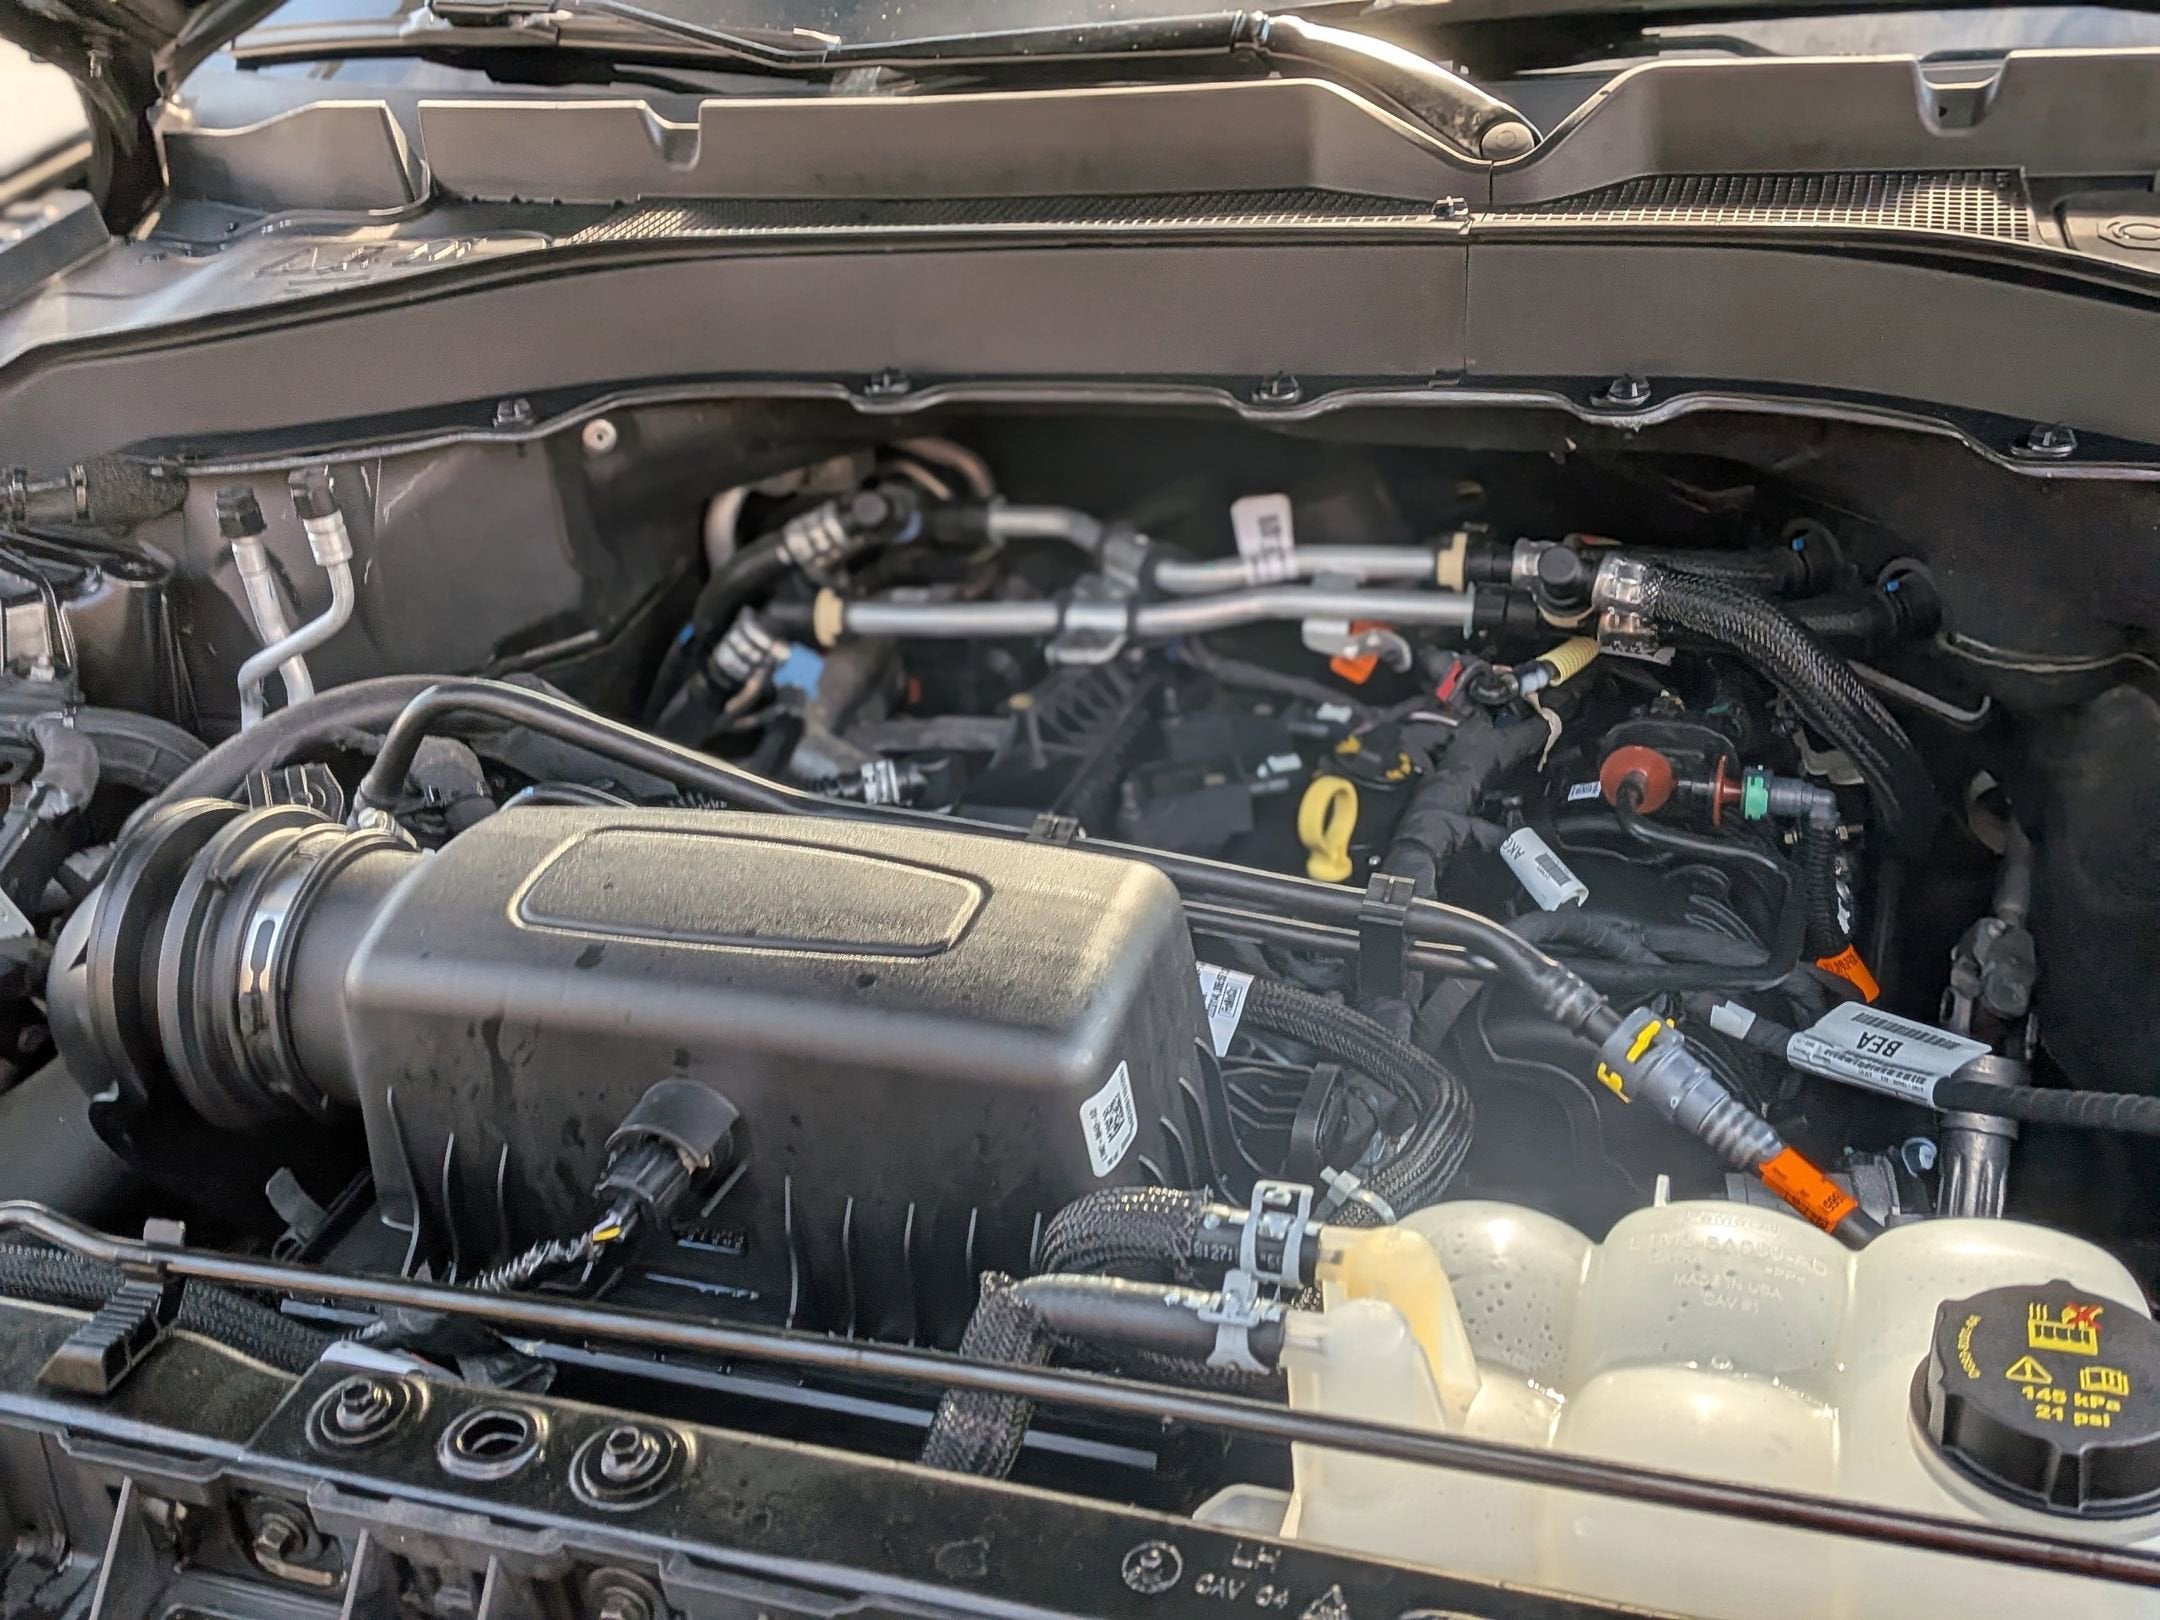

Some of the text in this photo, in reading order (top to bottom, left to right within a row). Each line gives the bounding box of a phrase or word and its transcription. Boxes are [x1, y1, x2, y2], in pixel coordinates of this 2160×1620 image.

[1857, 1031, 1904, 1059] BEA
[2022, 1385, 2121, 1413] 145 kPa
[2035, 1403, 2111, 1428] 21 psi
[1232, 1542, 1281, 1574] LH
